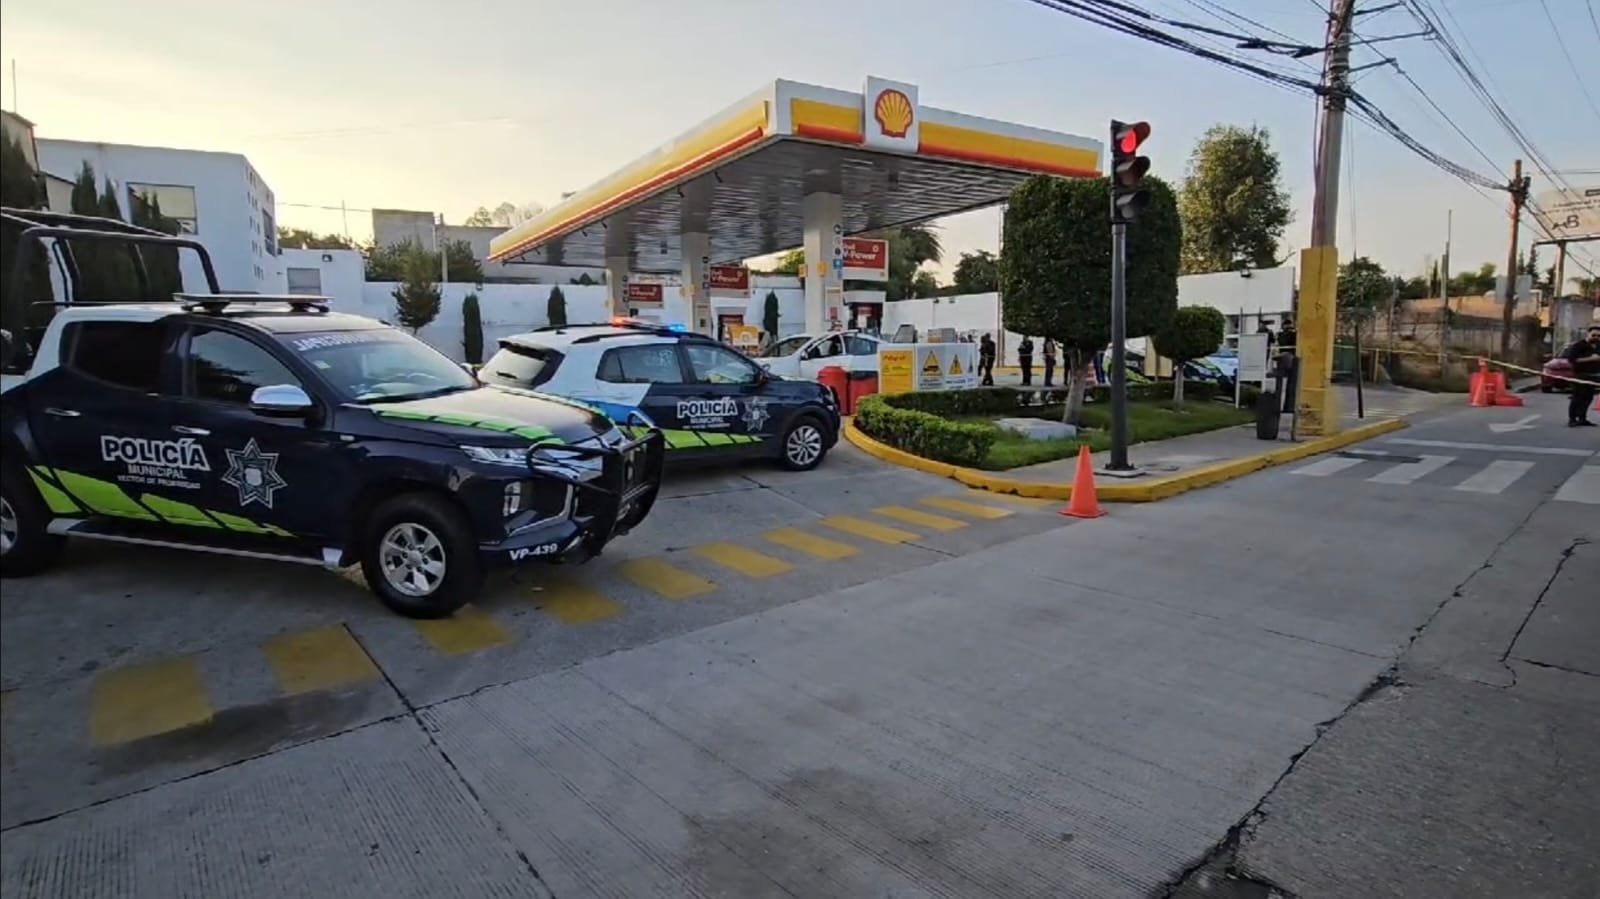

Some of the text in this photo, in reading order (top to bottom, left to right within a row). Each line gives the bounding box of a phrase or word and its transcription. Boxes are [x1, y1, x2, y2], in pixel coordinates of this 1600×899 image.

[677, 396, 738, 418] POLICÍA
[101, 436, 211, 470] POLICÍA
[128, 465, 187, 479] MUNICIPAL
